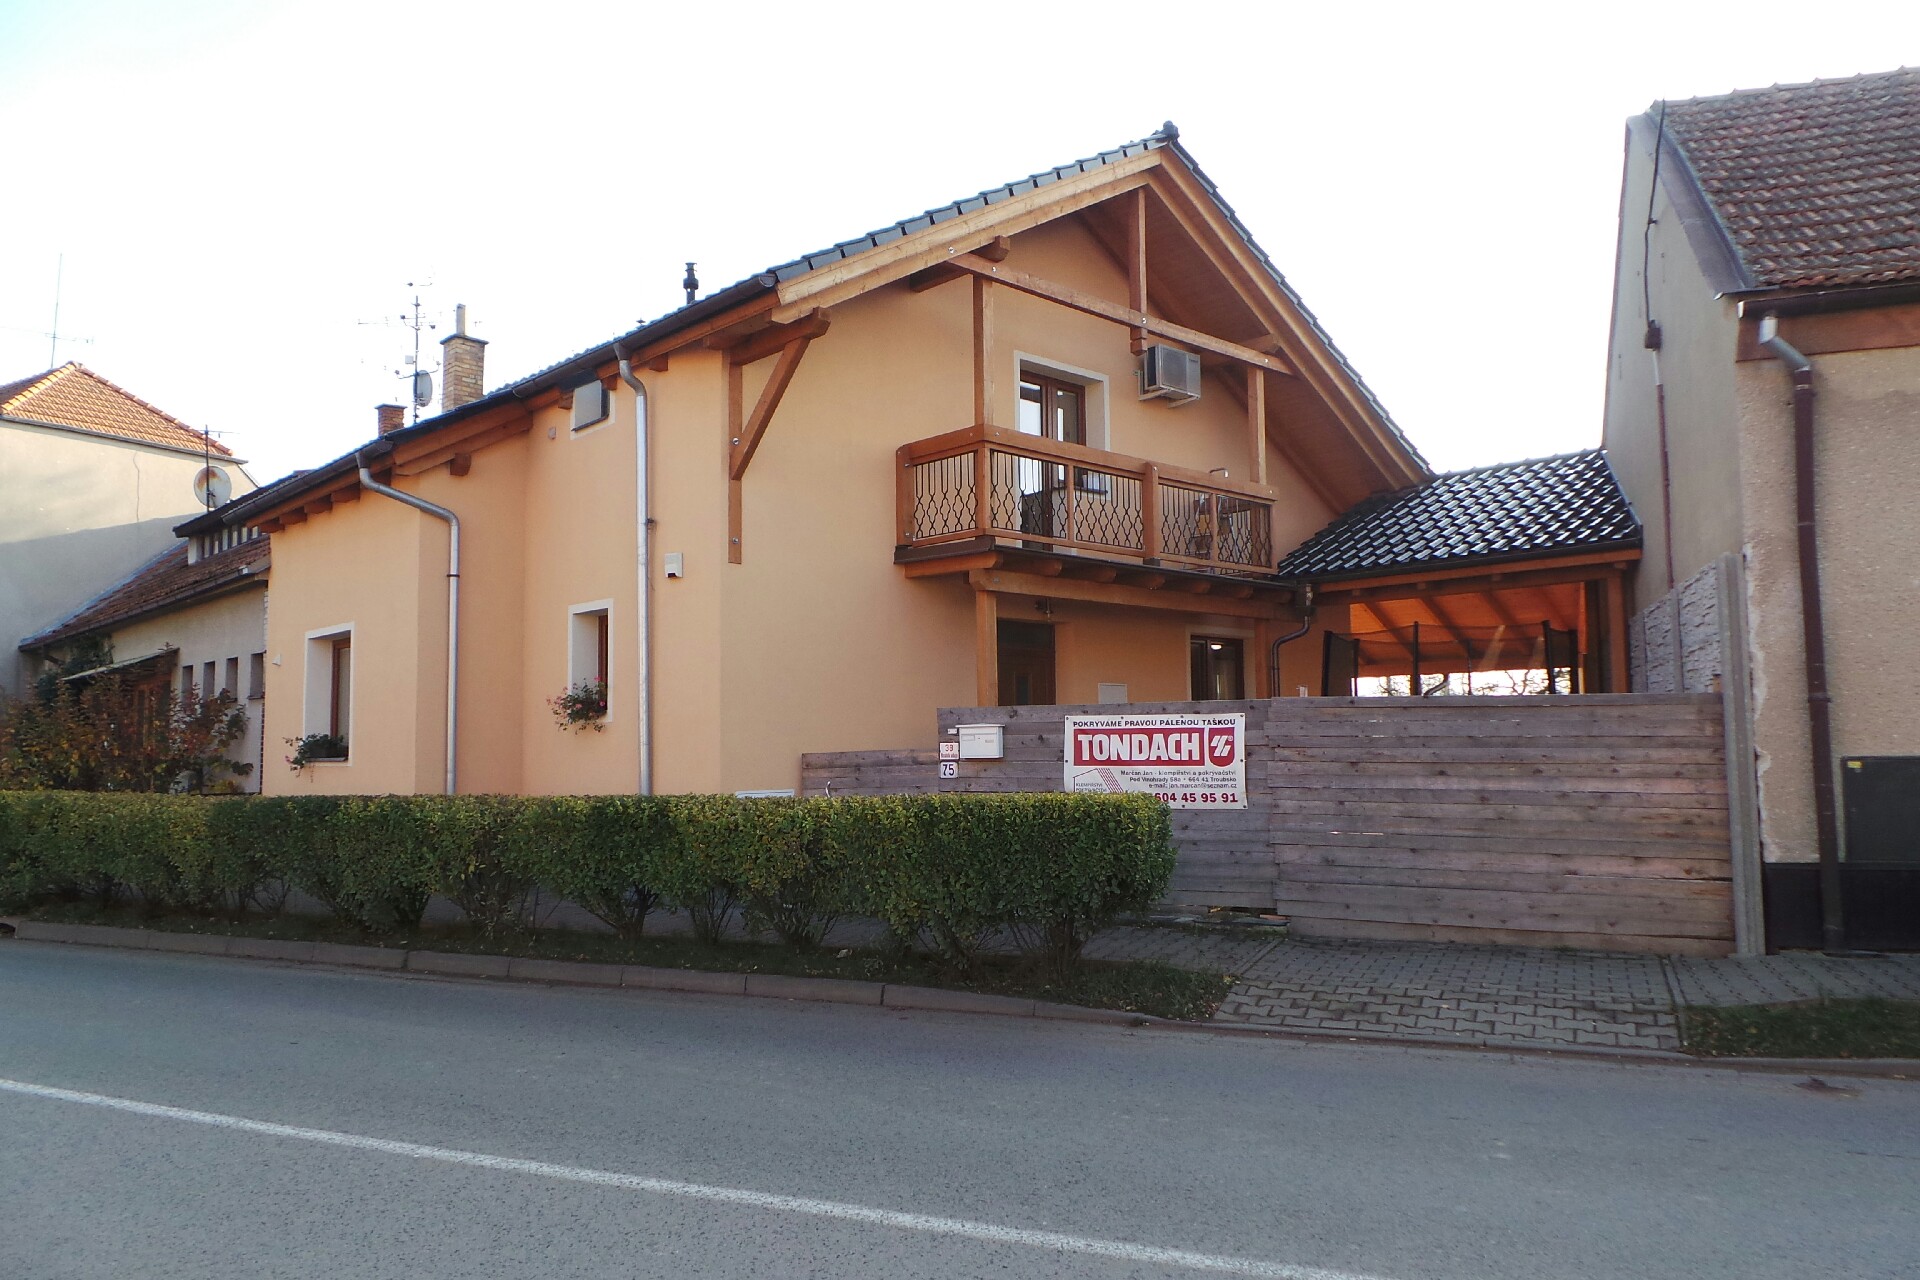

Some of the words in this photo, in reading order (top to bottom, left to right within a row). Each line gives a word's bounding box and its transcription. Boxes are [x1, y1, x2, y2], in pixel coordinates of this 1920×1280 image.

[1125, 719, 1157, 727] PRAVOU
[1202, 717, 1236, 726] TAŠKOU
[1078, 733, 1200, 760] TONDACH
[943, 764, 955, 776] 75
[1155, 792, 1177, 802] 604
[1181, 792, 1197, 803] 45
[1201, 792, 1217, 803] 95
[1221, 792, 1238, 803] 91
